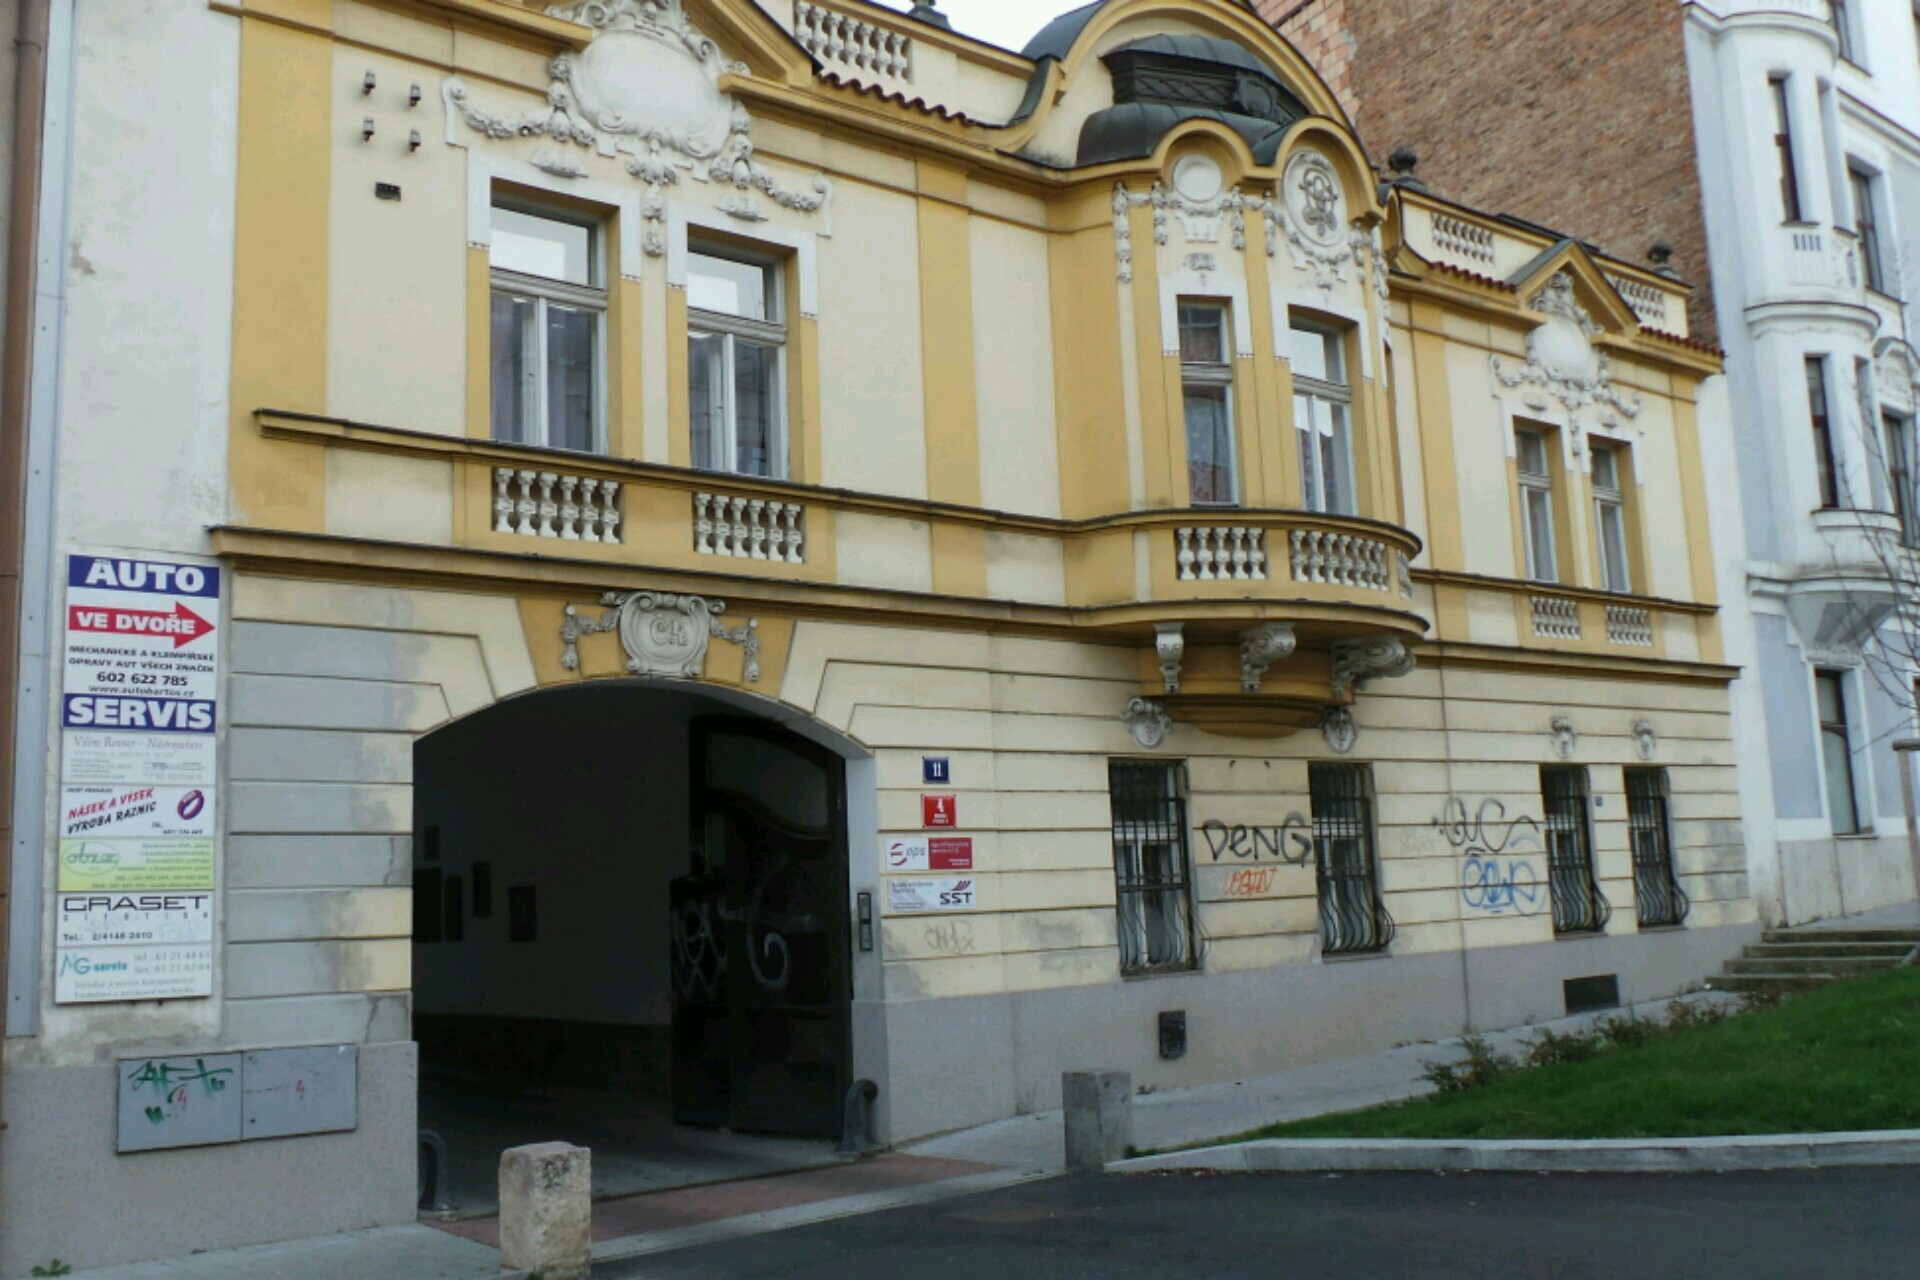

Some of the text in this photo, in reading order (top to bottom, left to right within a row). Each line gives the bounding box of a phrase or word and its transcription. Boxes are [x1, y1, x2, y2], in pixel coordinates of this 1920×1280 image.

[85, 559, 205, 592] AUTO
[76, 611, 196, 634] VE DVOŘE
[140, 649, 148, 657] A
[116, 660, 137, 668] AUT
[140, 661, 173, 671] VŠECH
[97, 672, 188, 686] 602 622 785
[68, 697, 212, 730] SERVIS
[63, 894, 209, 912] GRASET
[940, 892, 972, 905] SST
